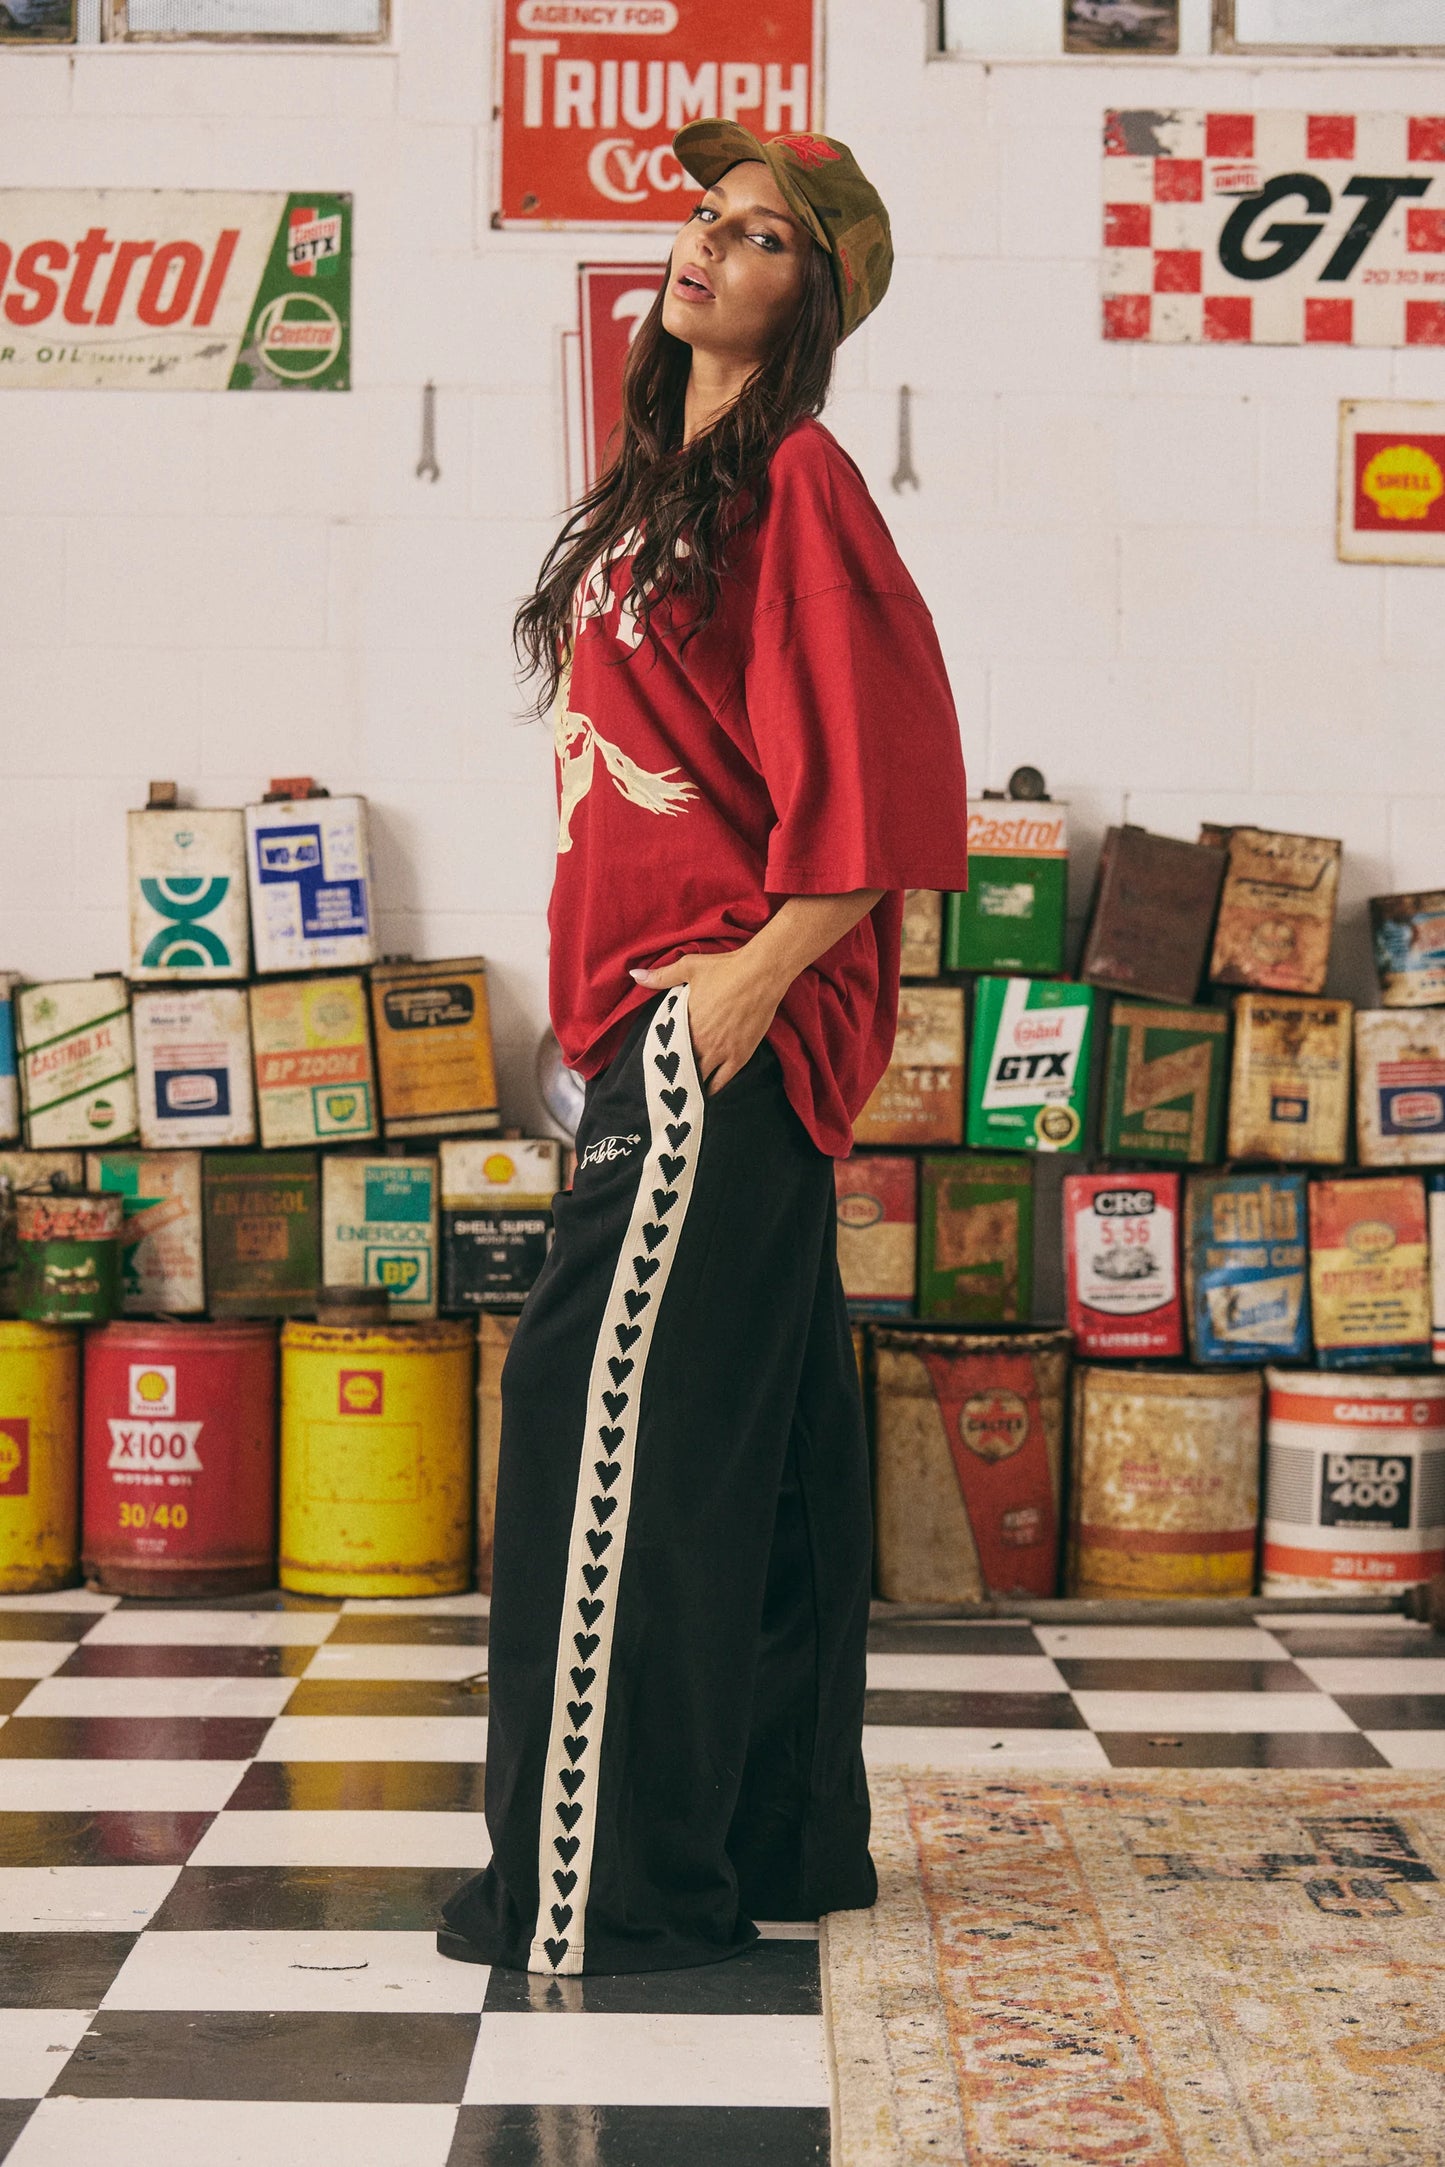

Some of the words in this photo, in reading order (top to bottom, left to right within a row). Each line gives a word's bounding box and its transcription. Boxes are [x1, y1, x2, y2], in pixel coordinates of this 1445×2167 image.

[529, 5, 613, 25] AGENCY
[624, 7, 666, 26] FOR
[508, 39, 809, 132] TRIUMPH
[1218, 172, 1434, 282] GT
[293, 236, 334, 261] GTX
[0, 226, 241, 327] strol
[37, 348, 80, 363] OIL
[1376, 473, 1431, 491] SHELL
[967, 814, 1064, 847] Castrol
[265, 1057, 296, 1081] BP
[996, 1052, 1072, 1081] GTX
[1095, 1191, 1154, 1215] CRC
[454, 1220, 498, 1235] SHELL
[499, 1219, 545, 1234] SUPER
[382, 1260, 418, 1285] BP
[1333, 1403, 1406, 1422] CALTEX
[1328, 1456, 1406, 1484] DELO
[1331, 1482, 1400, 1508] 400
[119, 1501, 189, 1529] 30/40
